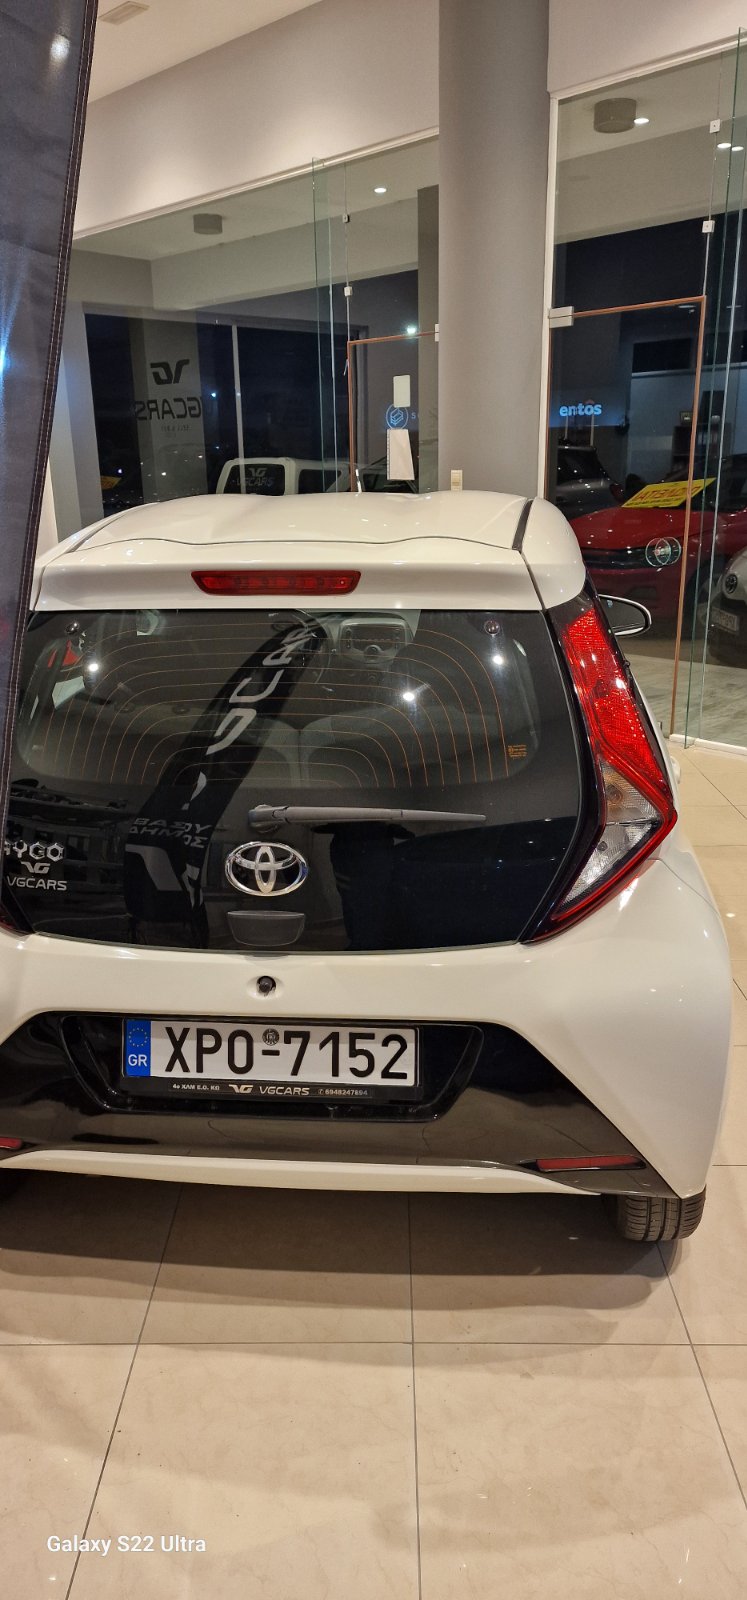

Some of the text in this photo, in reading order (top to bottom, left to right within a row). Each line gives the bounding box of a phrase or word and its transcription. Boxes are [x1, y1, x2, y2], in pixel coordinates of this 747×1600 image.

[7, 875, 68, 891] VGCARS
[127, 1053, 148, 1068] GR
[164, 1026, 408, 1081] XPO-7152
[259, 1085, 310, 1096] VGCARS
